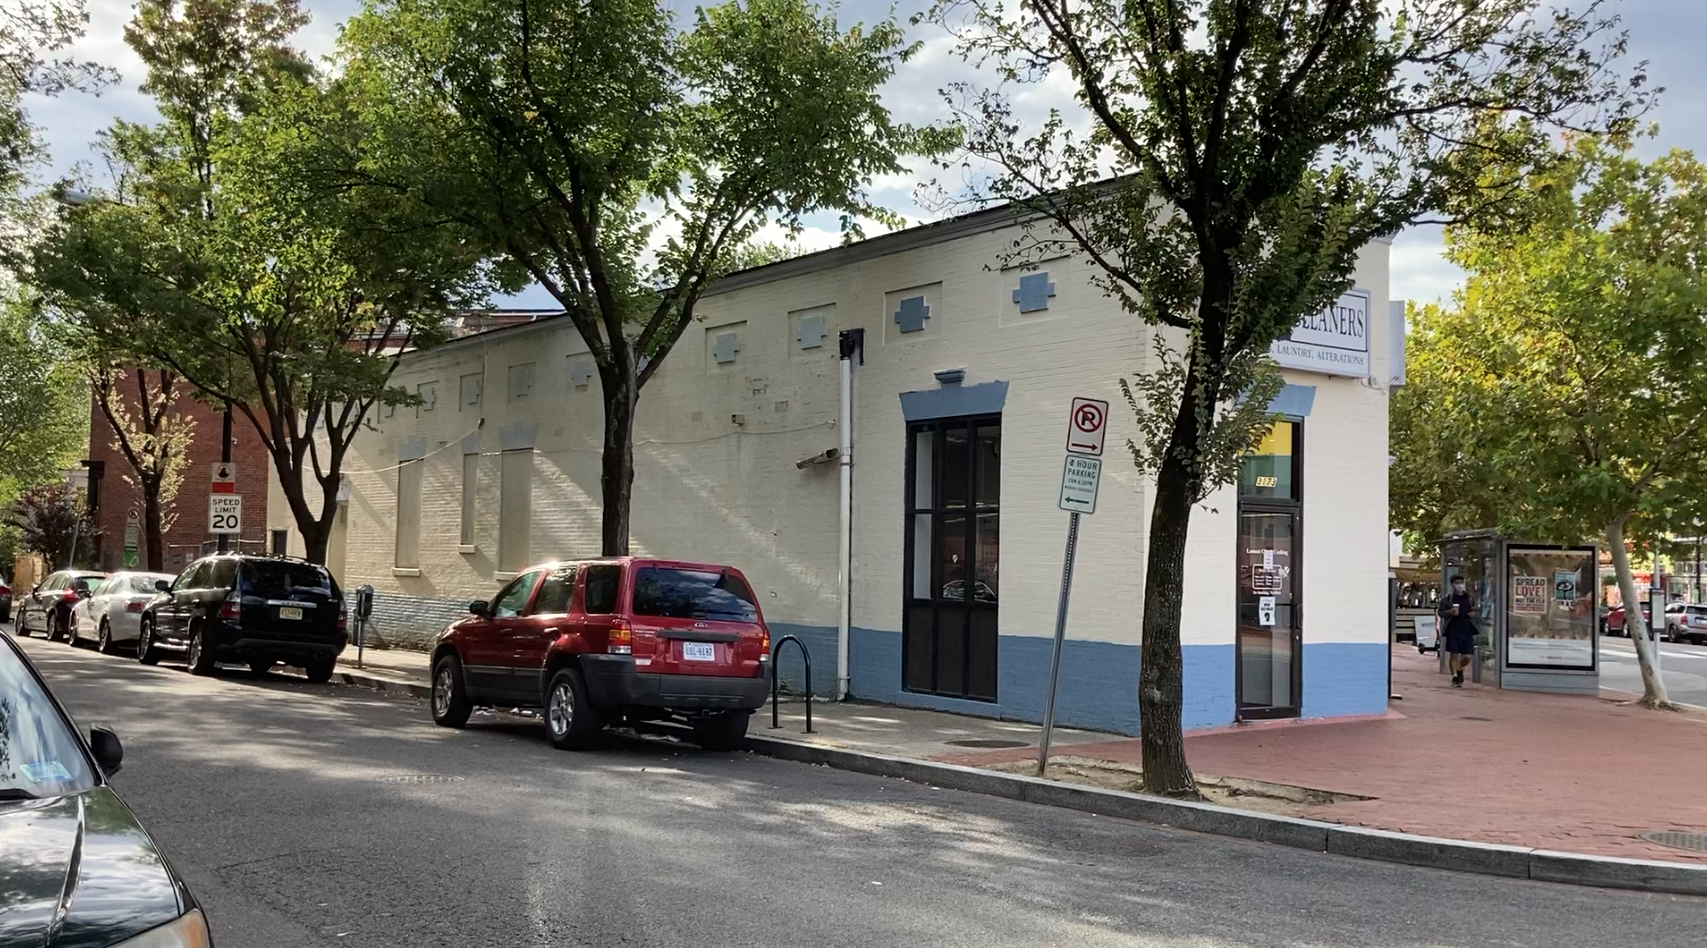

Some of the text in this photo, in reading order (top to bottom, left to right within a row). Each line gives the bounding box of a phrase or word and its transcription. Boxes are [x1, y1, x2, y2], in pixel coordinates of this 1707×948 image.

[1277, 344, 1364, 365] LAUNDRY, ALTERATIONS
[1077, 460, 1098, 470] HOUR
[1068, 467, 1096, 479] PARKING
[212, 498, 240, 506] SPEED
[214, 506, 237, 514] LIMIT
[212, 514, 238, 529] 20
[1515, 578, 1546, 587] SPREAD
[1515, 586, 1546, 597] LOVE!
